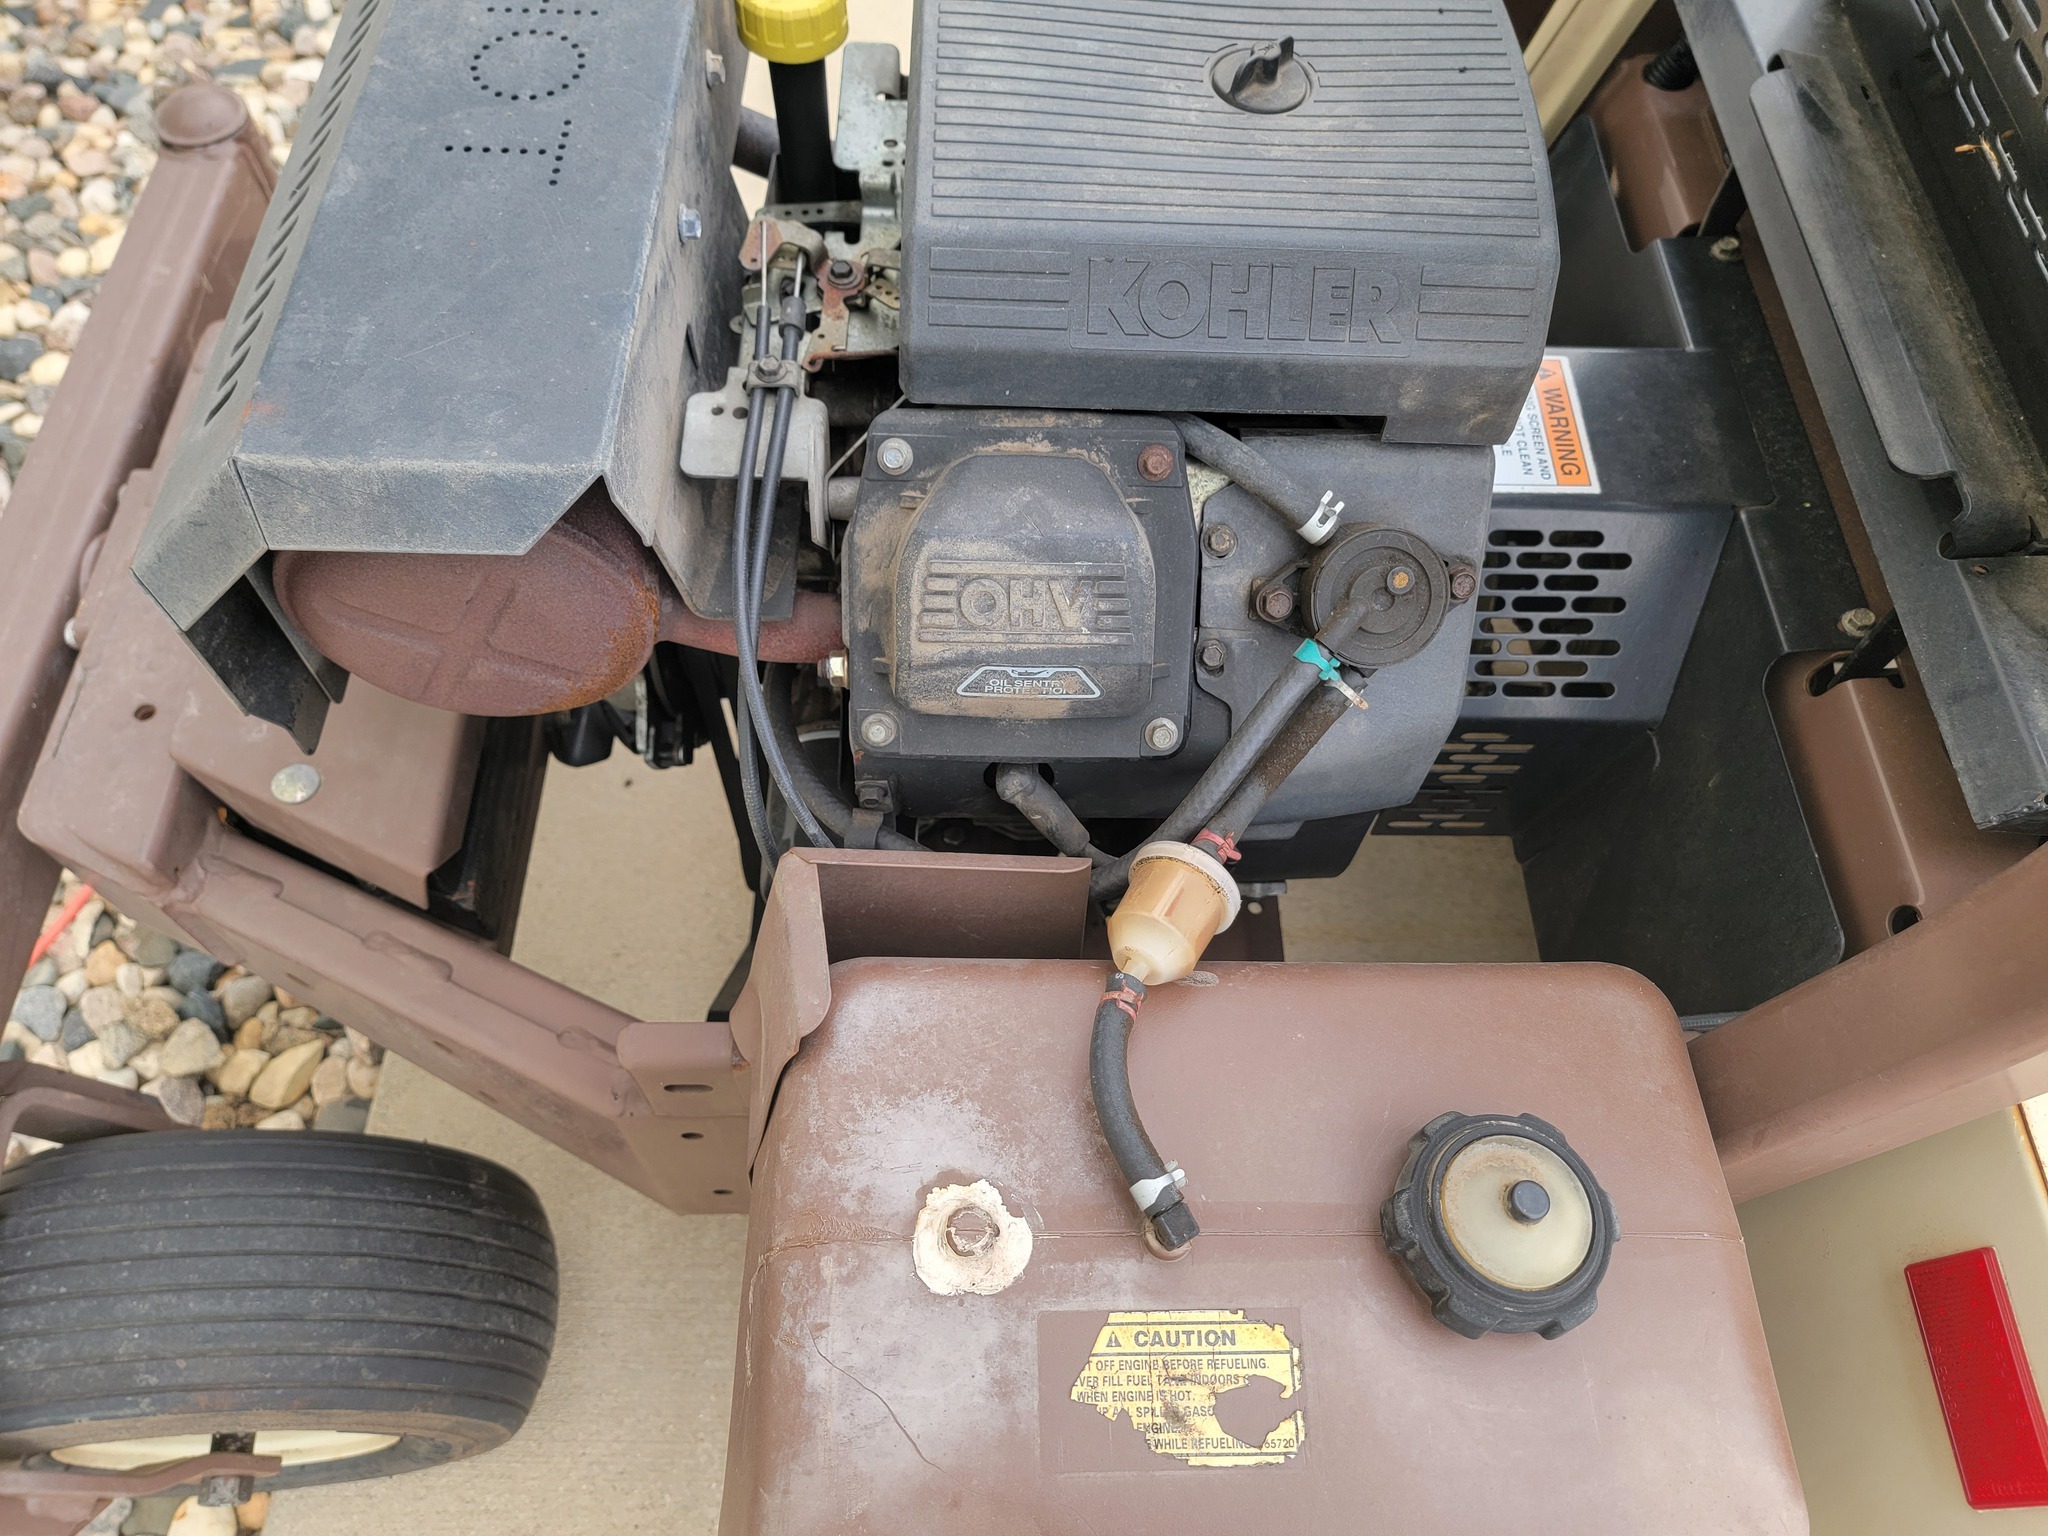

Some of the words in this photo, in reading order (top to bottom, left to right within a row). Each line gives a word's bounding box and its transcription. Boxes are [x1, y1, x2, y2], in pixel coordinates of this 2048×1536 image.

[444, 0, 599, 187] OT
[1086, 256, 1402, 344] KOHLER
[1542, 387, 1581, 476] WARNING
[1516, 441, 1534, 475] CLEAN
[1527, 413, 1546, 455] SCREEN
[1537, 458, 1552, 481] AND
[960, 577, 1093, 629] OHV
[988, 679, 1012, 687] OIL
[1014, 679, 1066, 688] SENTRY
[1133, 1329, 1236, 1347] CAUTION
[1095, 1359, 1115, 1371] OFF
[1118, 1358, 1159, 1371] ENGINE
[1162, 1358, 1203, 1371] BEFORE
[1206, 1357, 1270, 1370] REFUELING.
[1102, 1374, 1123, 1387] FILL
[1126, 1374, 1152, 1387] FUEL
[1190, 1373, 1240, 1387] INDOORS
[1076, 1391, 1108, 1402] WHEN
[1111, 1390, 1153, 1402] ENGINE
[1169, 1390, 1195, 1402] HOT.
[1154, 1438, 1188, 1450] WHILE
